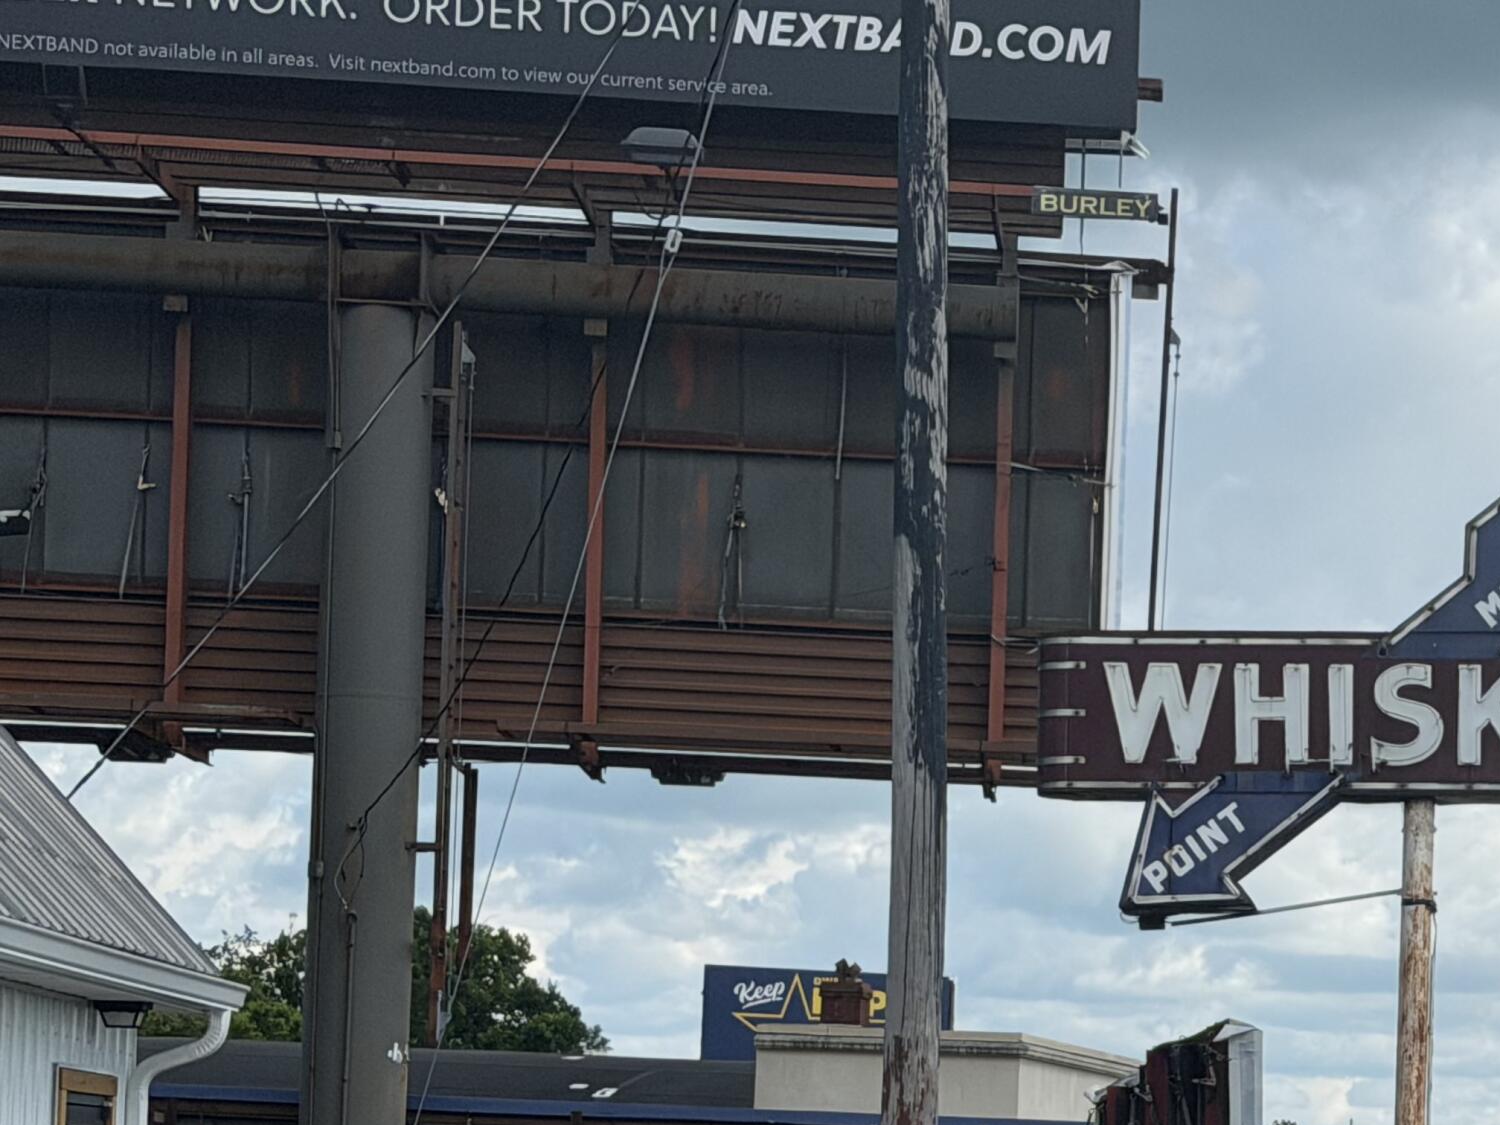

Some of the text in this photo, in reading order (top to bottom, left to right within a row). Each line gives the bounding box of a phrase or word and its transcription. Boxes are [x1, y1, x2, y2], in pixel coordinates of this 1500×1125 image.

[384, 0, 543, 32] ORDER
[556, 0, 717, 43] TODAY!
[732, 8, 1111, 66] NEXTBD.COM
[0, 34, 773, 96] NEXTBAND not available in all areas. Visit nextband.com to view our current service area.
[1040, 193, 1152, 217] BURLEY
[1142, 801, 1246, 894] POINT
[733, 980, 786, 1007] Keep
